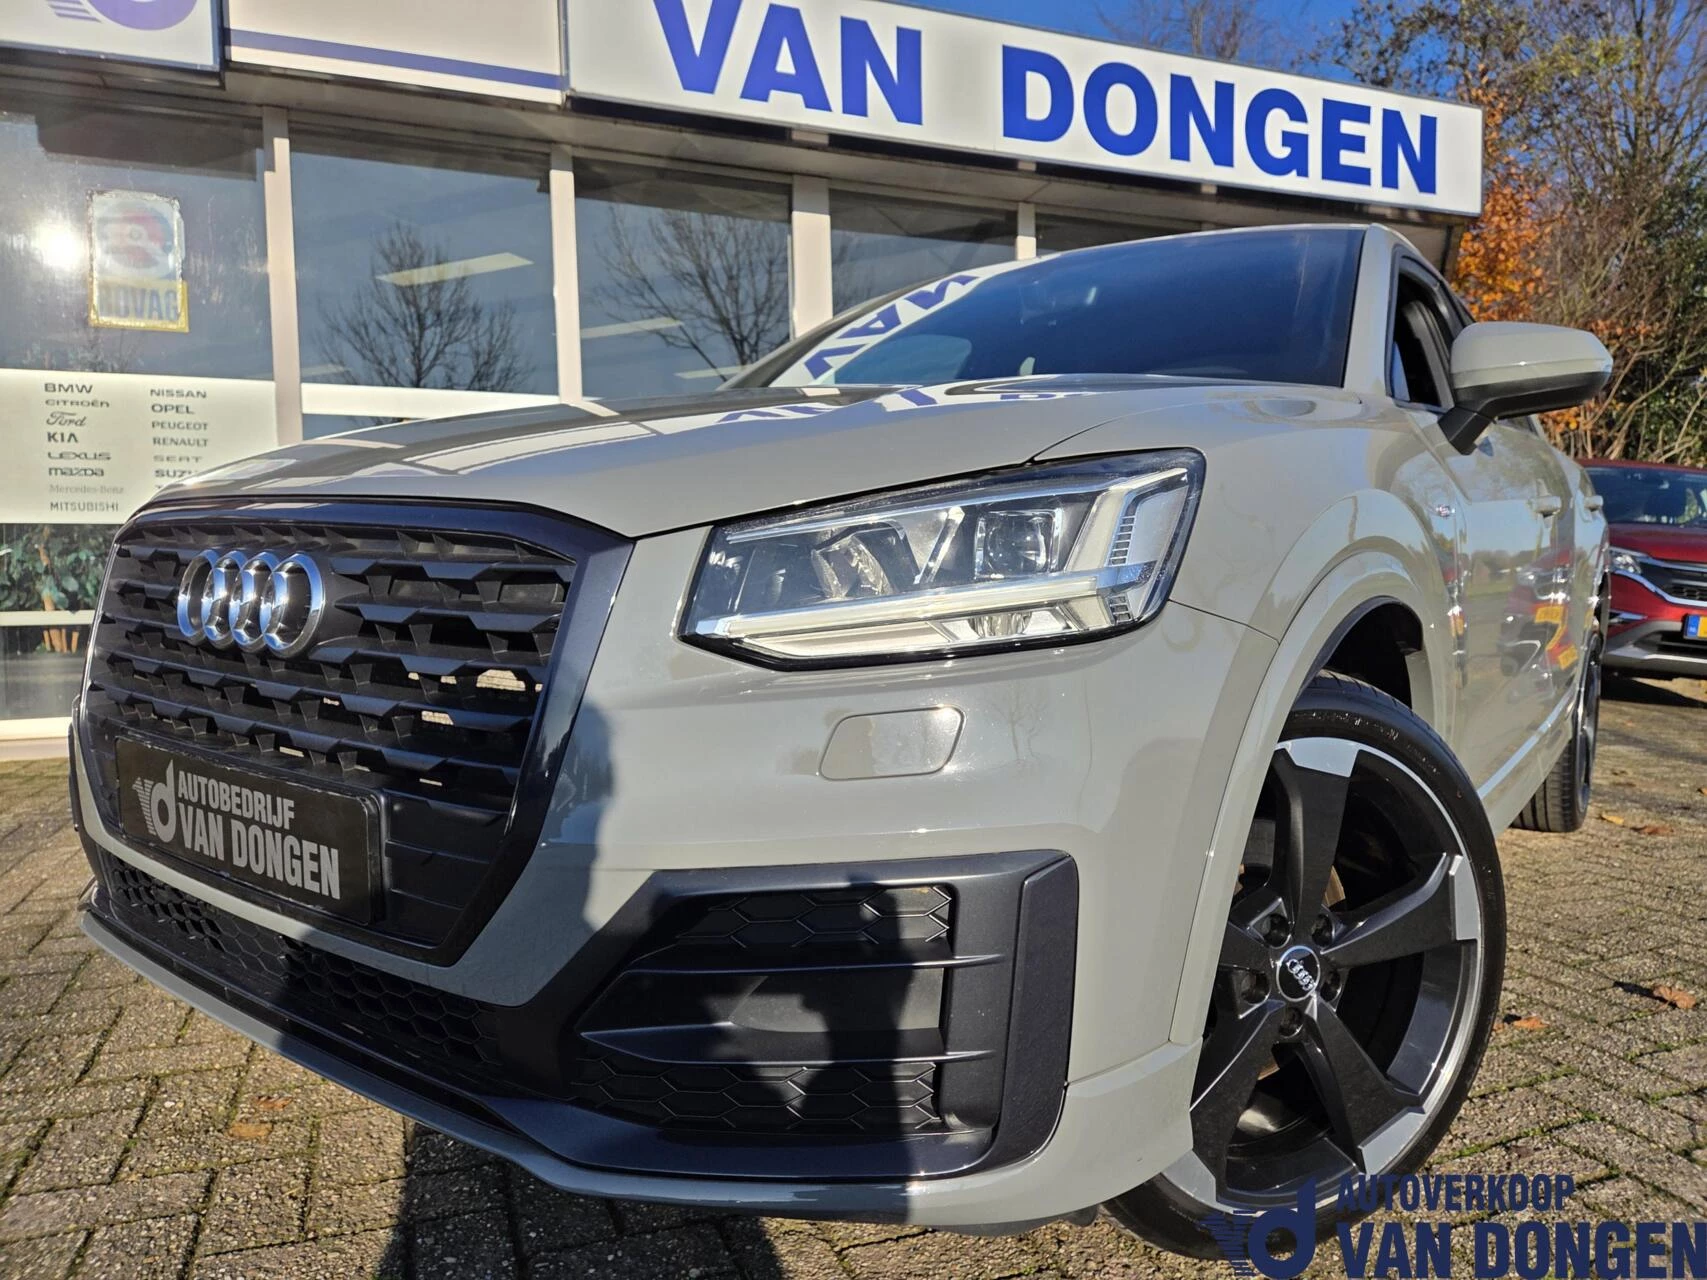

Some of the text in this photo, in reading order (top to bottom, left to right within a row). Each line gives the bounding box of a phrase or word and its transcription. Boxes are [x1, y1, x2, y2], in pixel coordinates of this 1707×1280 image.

[653, 0, 1438, 195] VAN DONGEN
[44, 382, 93, 394] BMW
[150, 388, 207, 399] NISSAN
[151, 403, 195, 415] OPEL
[46, 412, 87, 427] Ford
[152, 420, 208, 431] PEUGEOT
[47, 432, 79, 443] KIA
[152, 437, 208, 448] RENAULT
[47, 451, 111, 461] LEXUS
[153, 454, 202, 463] SEAT
[50, 484, 124, 495] Mercedes-Benz
[50, 502, 119, 512] MITSUBISHI
[178, 770, 295, 830] AUTOBEDRIJF
[178, 802, 341, 900] VAN DONGEN
